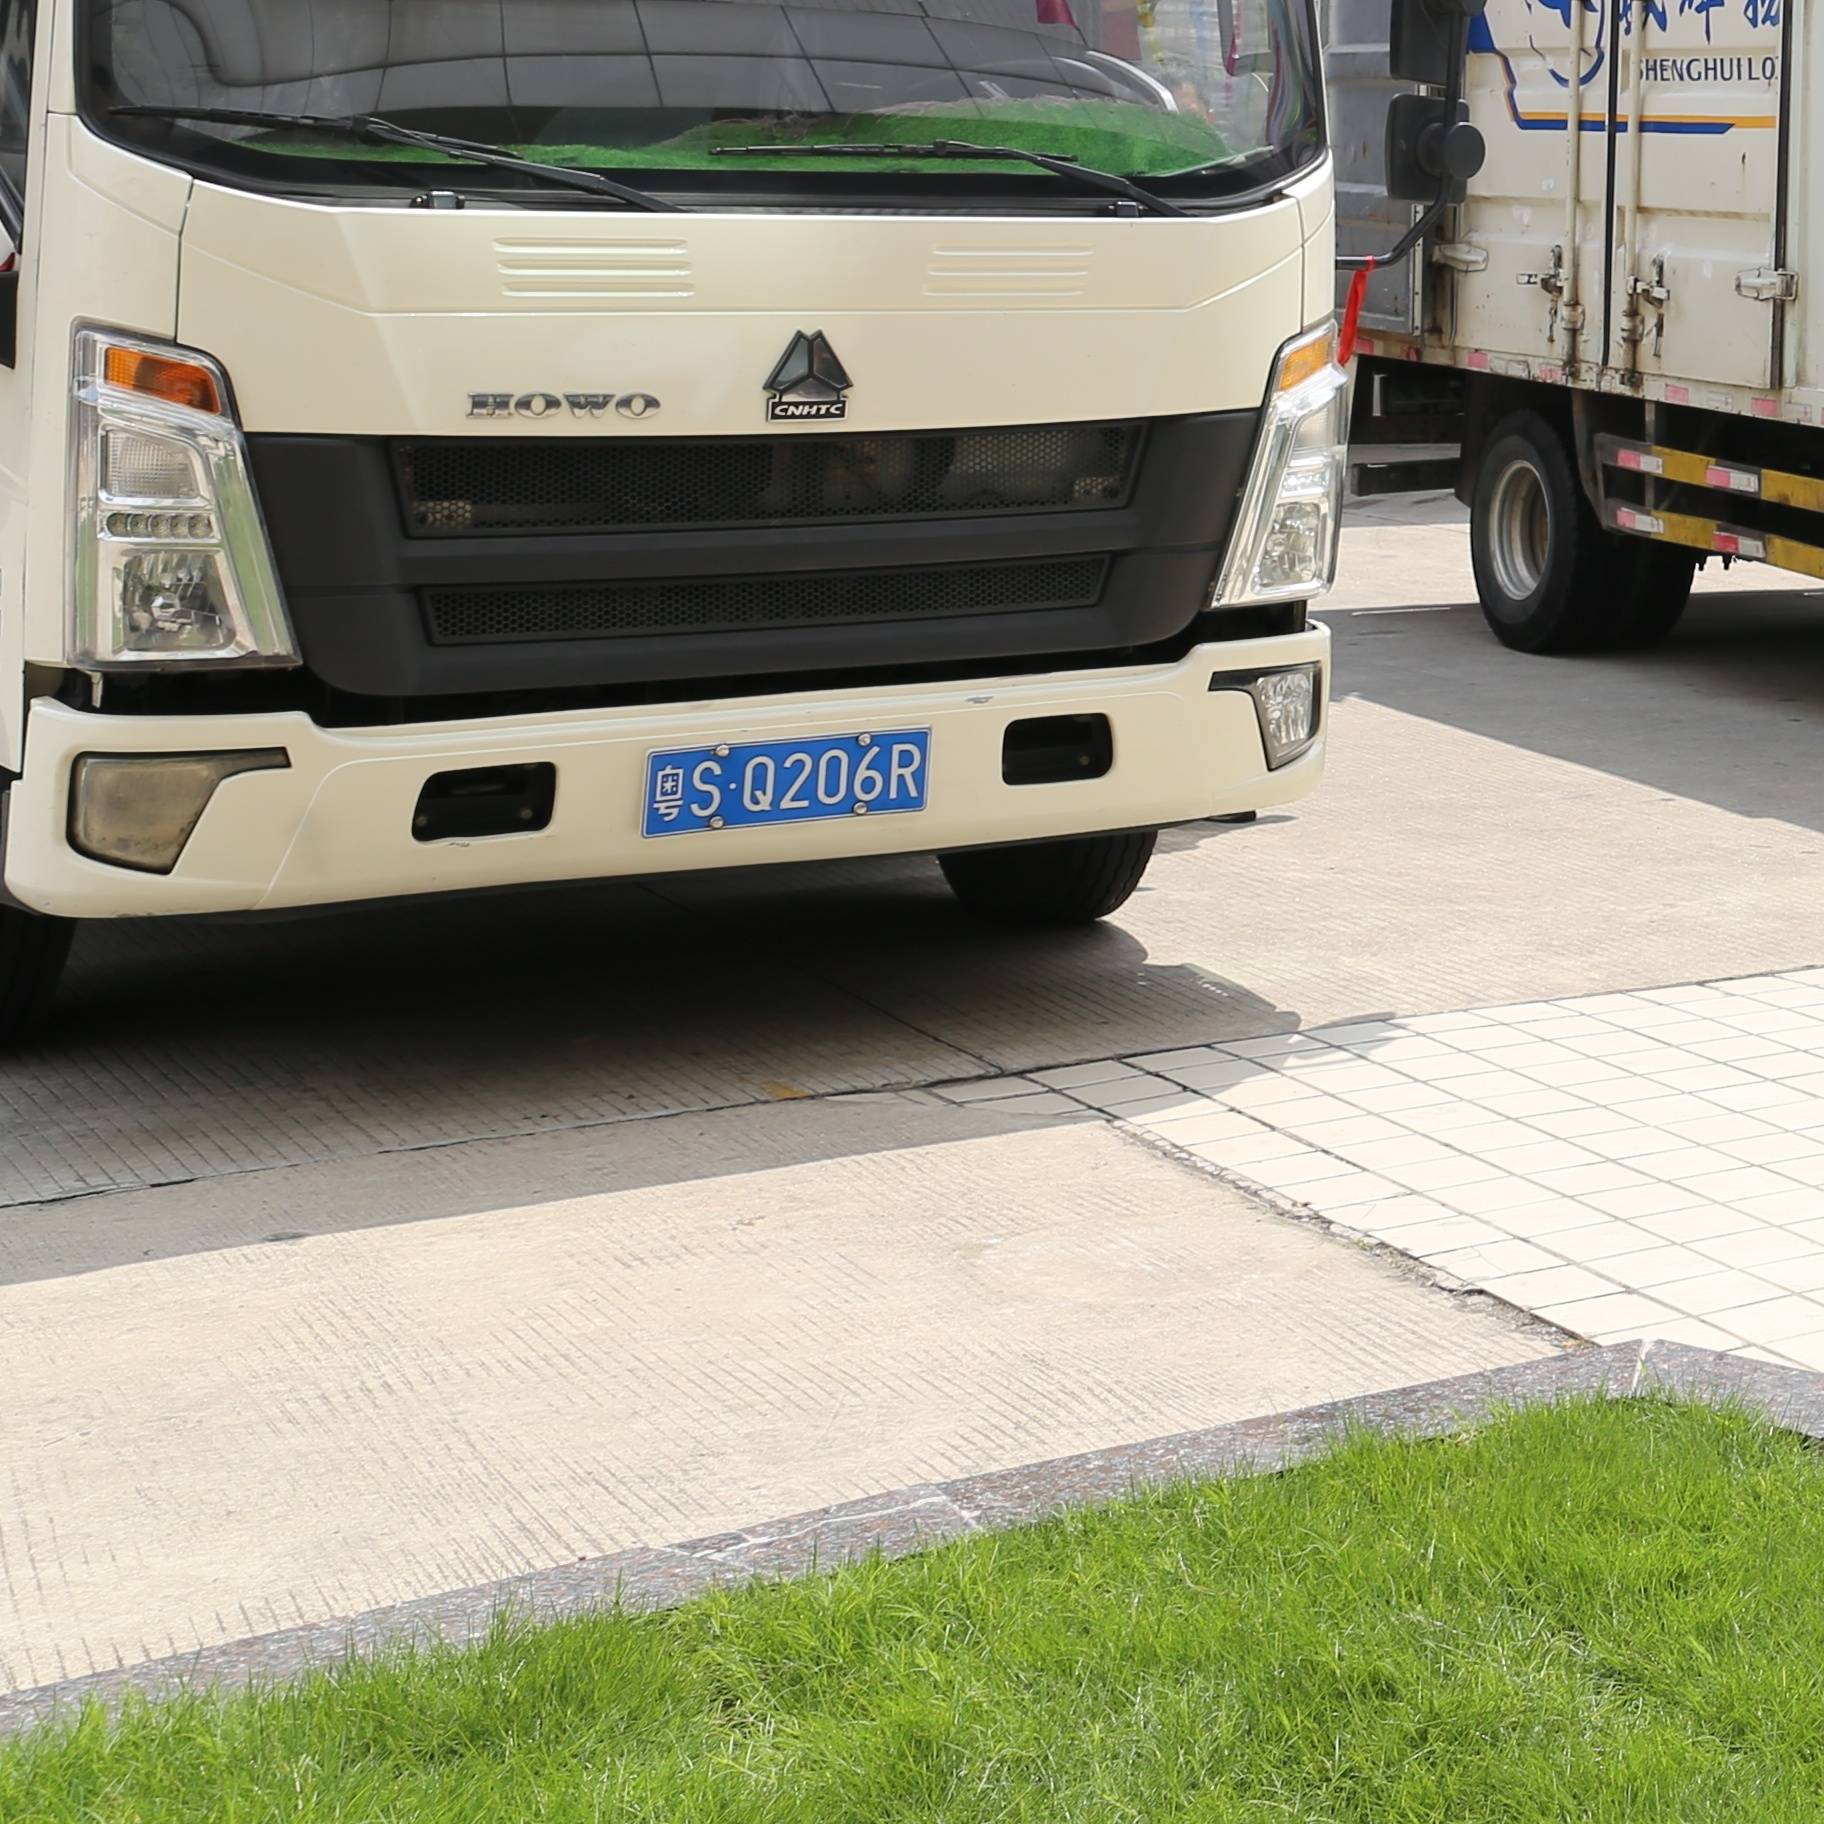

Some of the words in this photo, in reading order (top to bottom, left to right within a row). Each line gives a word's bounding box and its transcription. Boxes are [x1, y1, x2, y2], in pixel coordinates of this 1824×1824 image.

[1747, 57, 1779, 82] LO
[465, 390, 662, 421] HOWO
[773, 403, 844, 418] CNHTC
